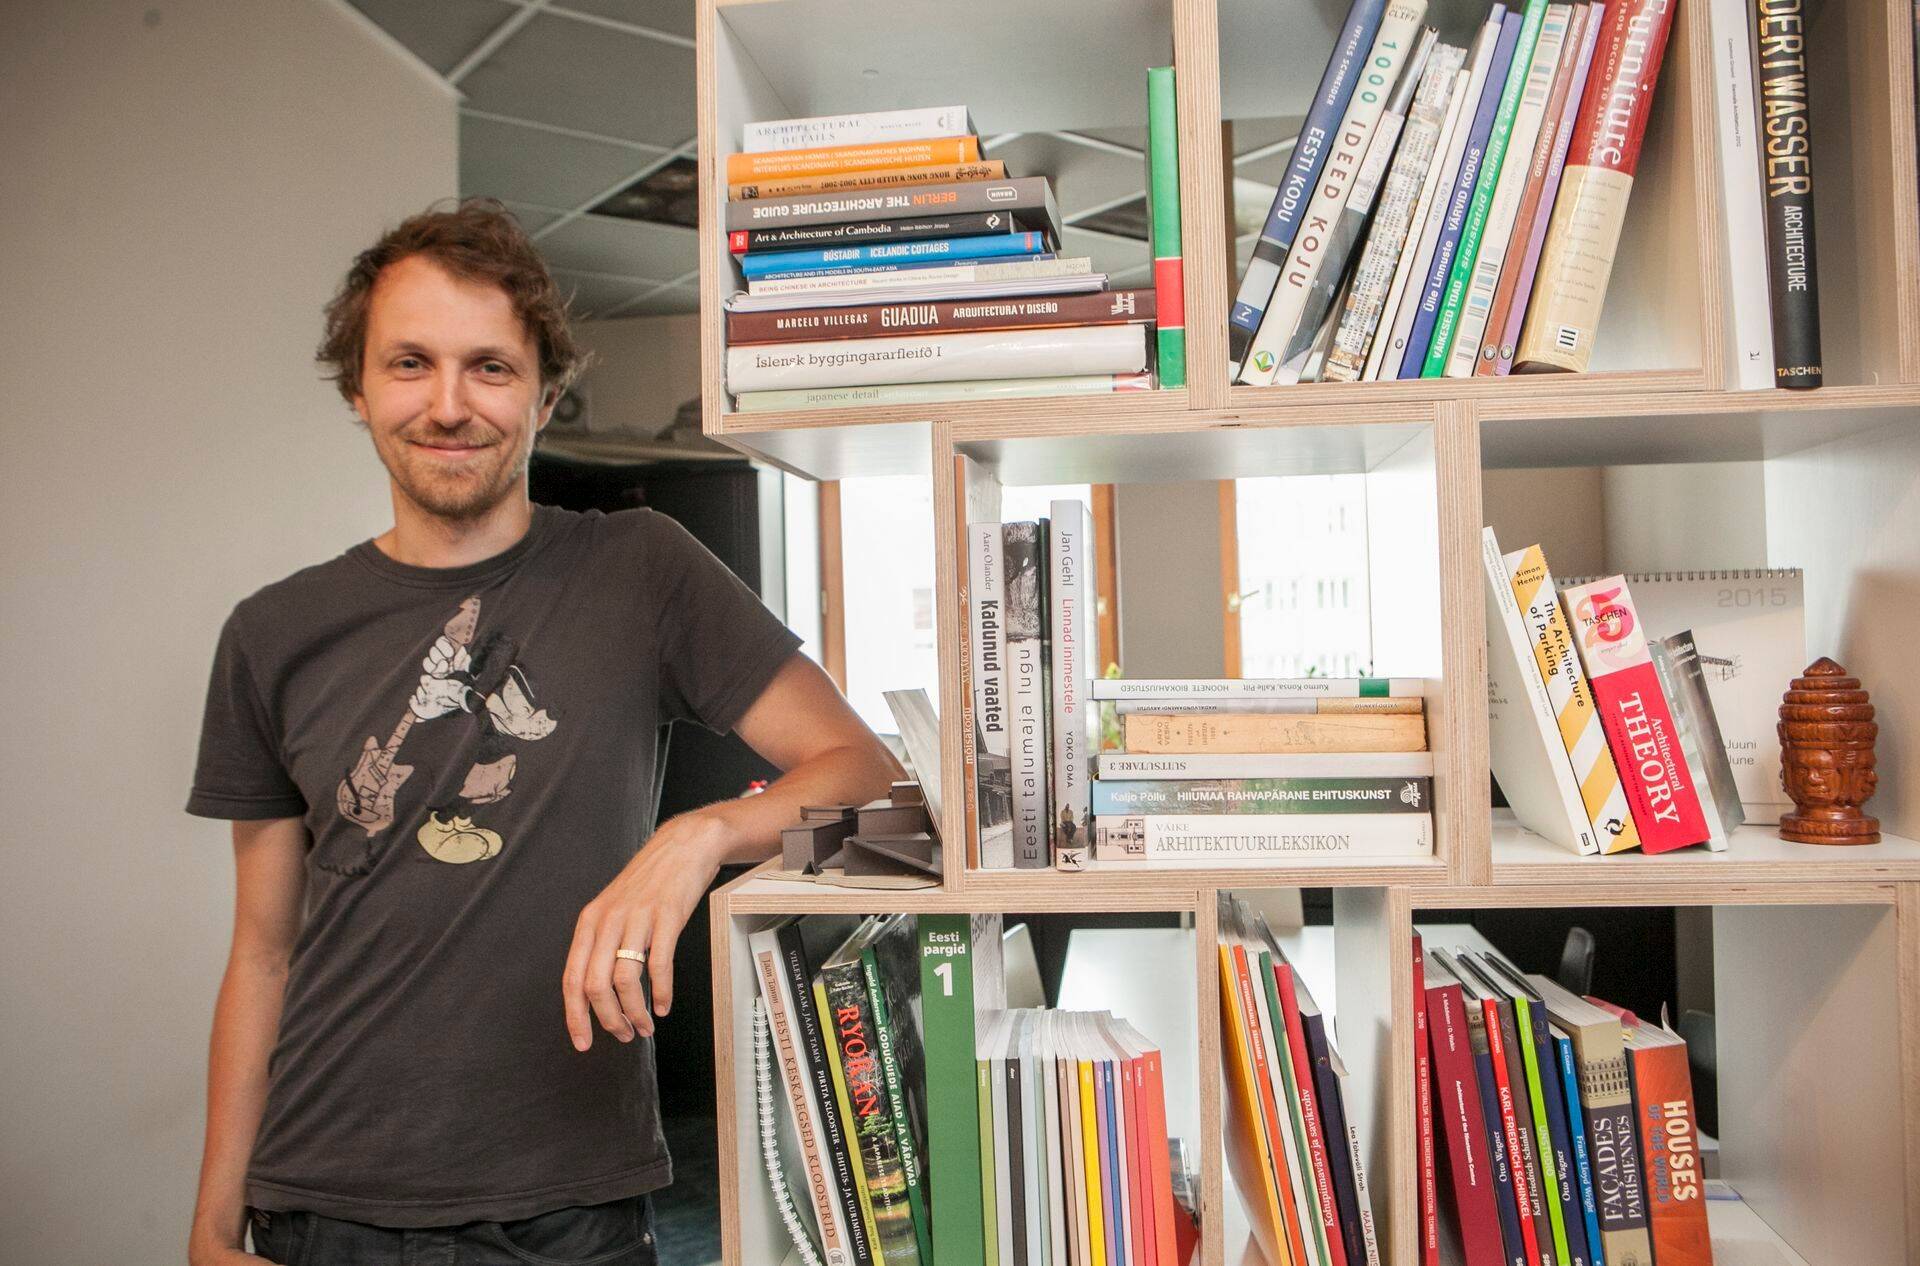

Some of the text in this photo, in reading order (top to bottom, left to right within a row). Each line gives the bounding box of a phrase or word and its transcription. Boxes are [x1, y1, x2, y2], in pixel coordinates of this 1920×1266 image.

[1326, 59, 1350, 106] SCHNEIDER
[1360, 41, 1398, 104] 1000
[1585, 0, 1628, 161] FROM ROCOCO TO ART DECO
[1601, 0, 1667, 165] Furniture
[780, 130, 835, 147] DETAILS
[1323, 119, 1366, 199] IDEED
[907, 172, 928, 183] KONG
[1278, 126, 1326, 223] EESTI KODU
[751, 189, 957, 219] BERLIN THE ARCHITECTURE GUIDE
[754, 232, 769, 242] Art
[778, 228, 831, 240] Architecture
[833, 227, 843, 236] of
[844, 223, 891, 235] Cambodia
[1421, 146, 1482, 313] Ülle Linnuste VÄRVID KODUS
[868, 240, 949, 258] ICELANDIC COTTAGES
[1288, 215, 1328, 288] KOJU
[1431, 307, 1455, 359] VÄIKESED
[1445, 278, 1463, 310] TOAD
[1461, 193, 1488, 269] sisustatud
[1496, 122, 1508, 135] &
[1782, 203, 1807, 292] ARCHITECTURE
[758, 284, 778, 293] BEING
[779, 282, 808, 292] CHINESE
[817, 278, 866, 289] ARCHITECTURE
[776, 301, 1057, 330] MARCELO VILLEGAS GUADUA ARQUITECTURA Y DISEÑO
[754, 345, 942, 368] Íslensk byggingararfleifð I
[1776, 365, 1823, 377] TASCHEN
[806, 391, 848, 403] japanese
[850, 388, 879, 400] detail
[982, 531, 994, 592] Aare Olander
[1515, 565, 1542, 579] Simon
[1516, 573, 1546, 588] Henley
[1060, 530, 1075, 714] Jan Gehl Linnad inimestele
[1583, 606, 1629, 628] TASCHEN
[1716, 587, 1787, 608] 2015
[979, 598, 1003, 734] Kadunud vaated
[1528, 603, 1544, 620] of
[1536, 624, 1560, 677] Parking
[1542, 599, 1584, 708] The Architecture
[1120, 683, 1188, 694] BIOKAHJUSTUSED
[1191, 683, 1229, 693] HOONETE
[1242, 682, 1255, 692] Pilt
[1256, 682, 1276, 692] Kalle
[1303, 681, 1329, 691] Kurmo
[962, 706, 973, 764] mõisakodu
[1014, 647, 1038, 861] Eesti talumaja lugu
[1065, 730, 1074, 789] YOKO OMA
[1619, 691, 1681, 824] THEORY
[1651, 717, 1685, 793] Architectural
[1725, 739, 1757, 750] Juuni
[1109, 760, 1186, 771] SUITSUTARE 3
[1110, 792, 1137, 803] Kaljo
[1177, 790, 1225, 801] HIIUMAA
[1227, 786, 1310, 801] RAHVAPÄRANE
[1312, 789, 1392, 800] EHITUSKUNST
[1155, 834, 1350, 853] ARHITEKTUURILEKSIKON
[923, 943, 966, 956] pargid
[928, 931, 960, 943] Eesti
[933, 962, 954, 996] 1
[838, 1004, 879, 1117] RYOKAN
[868, 987, 917, 1188] Andersson KODUÕUEDE AIAD JA VÄRAVAD
[761, 958, 836, 1238] Jaan Tamm EESTI KESKAEGSED KLOOSTRID
[787, 949, 867, 1260] VILLEM RAAM, JAAN TAMM PIRITA KLOOSTER EHITUS- JA UURIMISLUGU
[871, 1142, 886, 1177] JAPANESE
[1302, 1089, 1334, 1227] Kohupiimavärv ja savikrohv
[1349, 1125, 1367, 1193] Lea Stroh
[1460, 1114, 1467, 1122] of
[1467, 1163, 1477, 1186] Century
[1491, 1129, 1508, 1182] Otto Wagner
[1498, 1086, 1530, 1219] KARL FRIEDRICH SCHINKEL
[1518, 1127, 1542, 1217] Karl Friedrich Schinkel
[1554, 1148, 1571, 1201] Otto Wagner
[1575, 1133, 1596, 1214] Frank Lloyd Wright
[1594, 1118, 1624, 1221] FAÇADES
[1616, 1115, 1643, 1219] PARISIENNES
[1646, 1103, 1671, 1203] OF THE WORLD
[1663, 1100, 1698, 1201] HOUSES
[1360, 1209, 1375, 1248] MAJA JA
